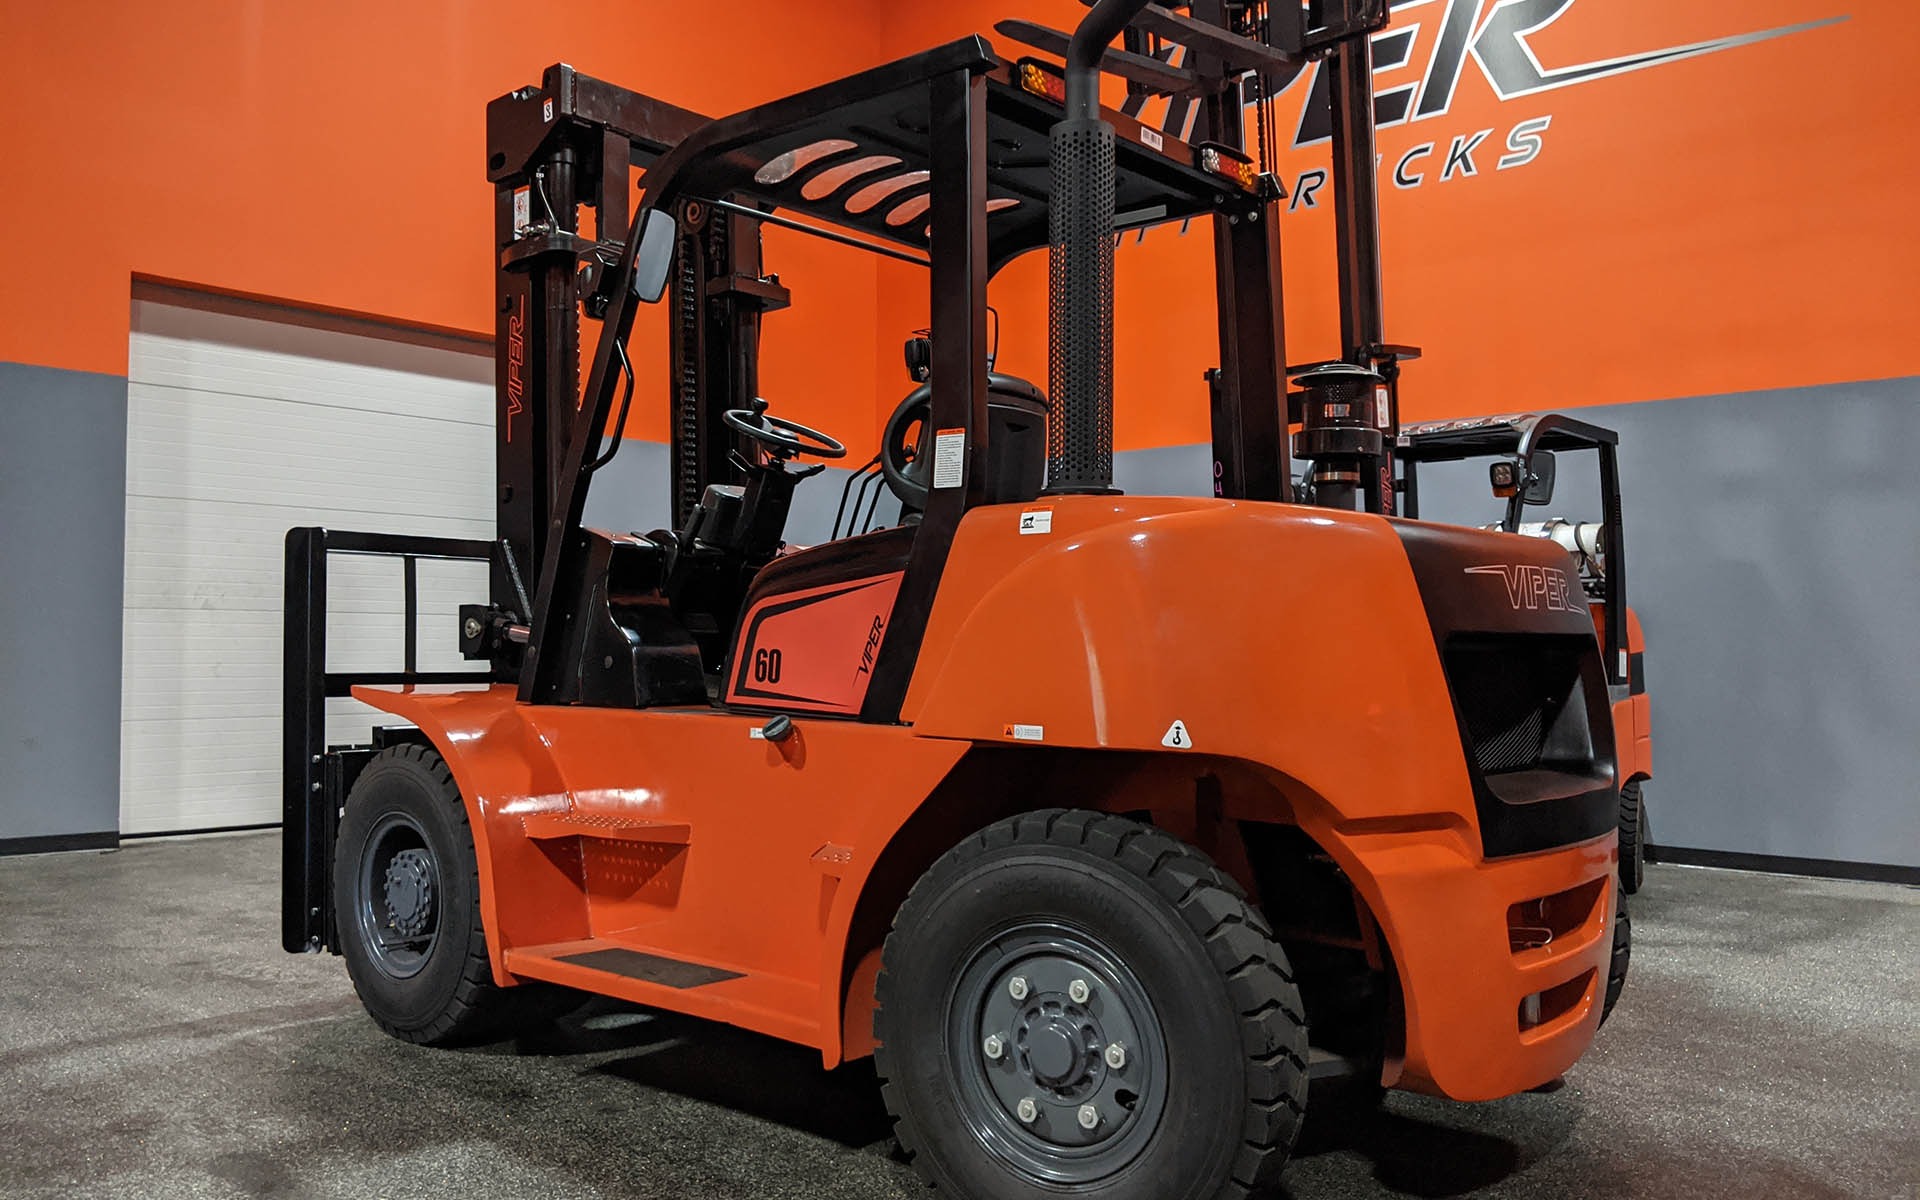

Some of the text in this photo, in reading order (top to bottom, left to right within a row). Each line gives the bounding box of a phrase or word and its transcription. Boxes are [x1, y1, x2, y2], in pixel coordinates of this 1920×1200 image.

[1287, 115, 1552, 214] RCKS
[507, 294, 524, 442] VIPER
[1464, 564, 1586, 614] VIPER
[755, 648, 781, 683] 60
[855, 612, 887, 679] VIPER
